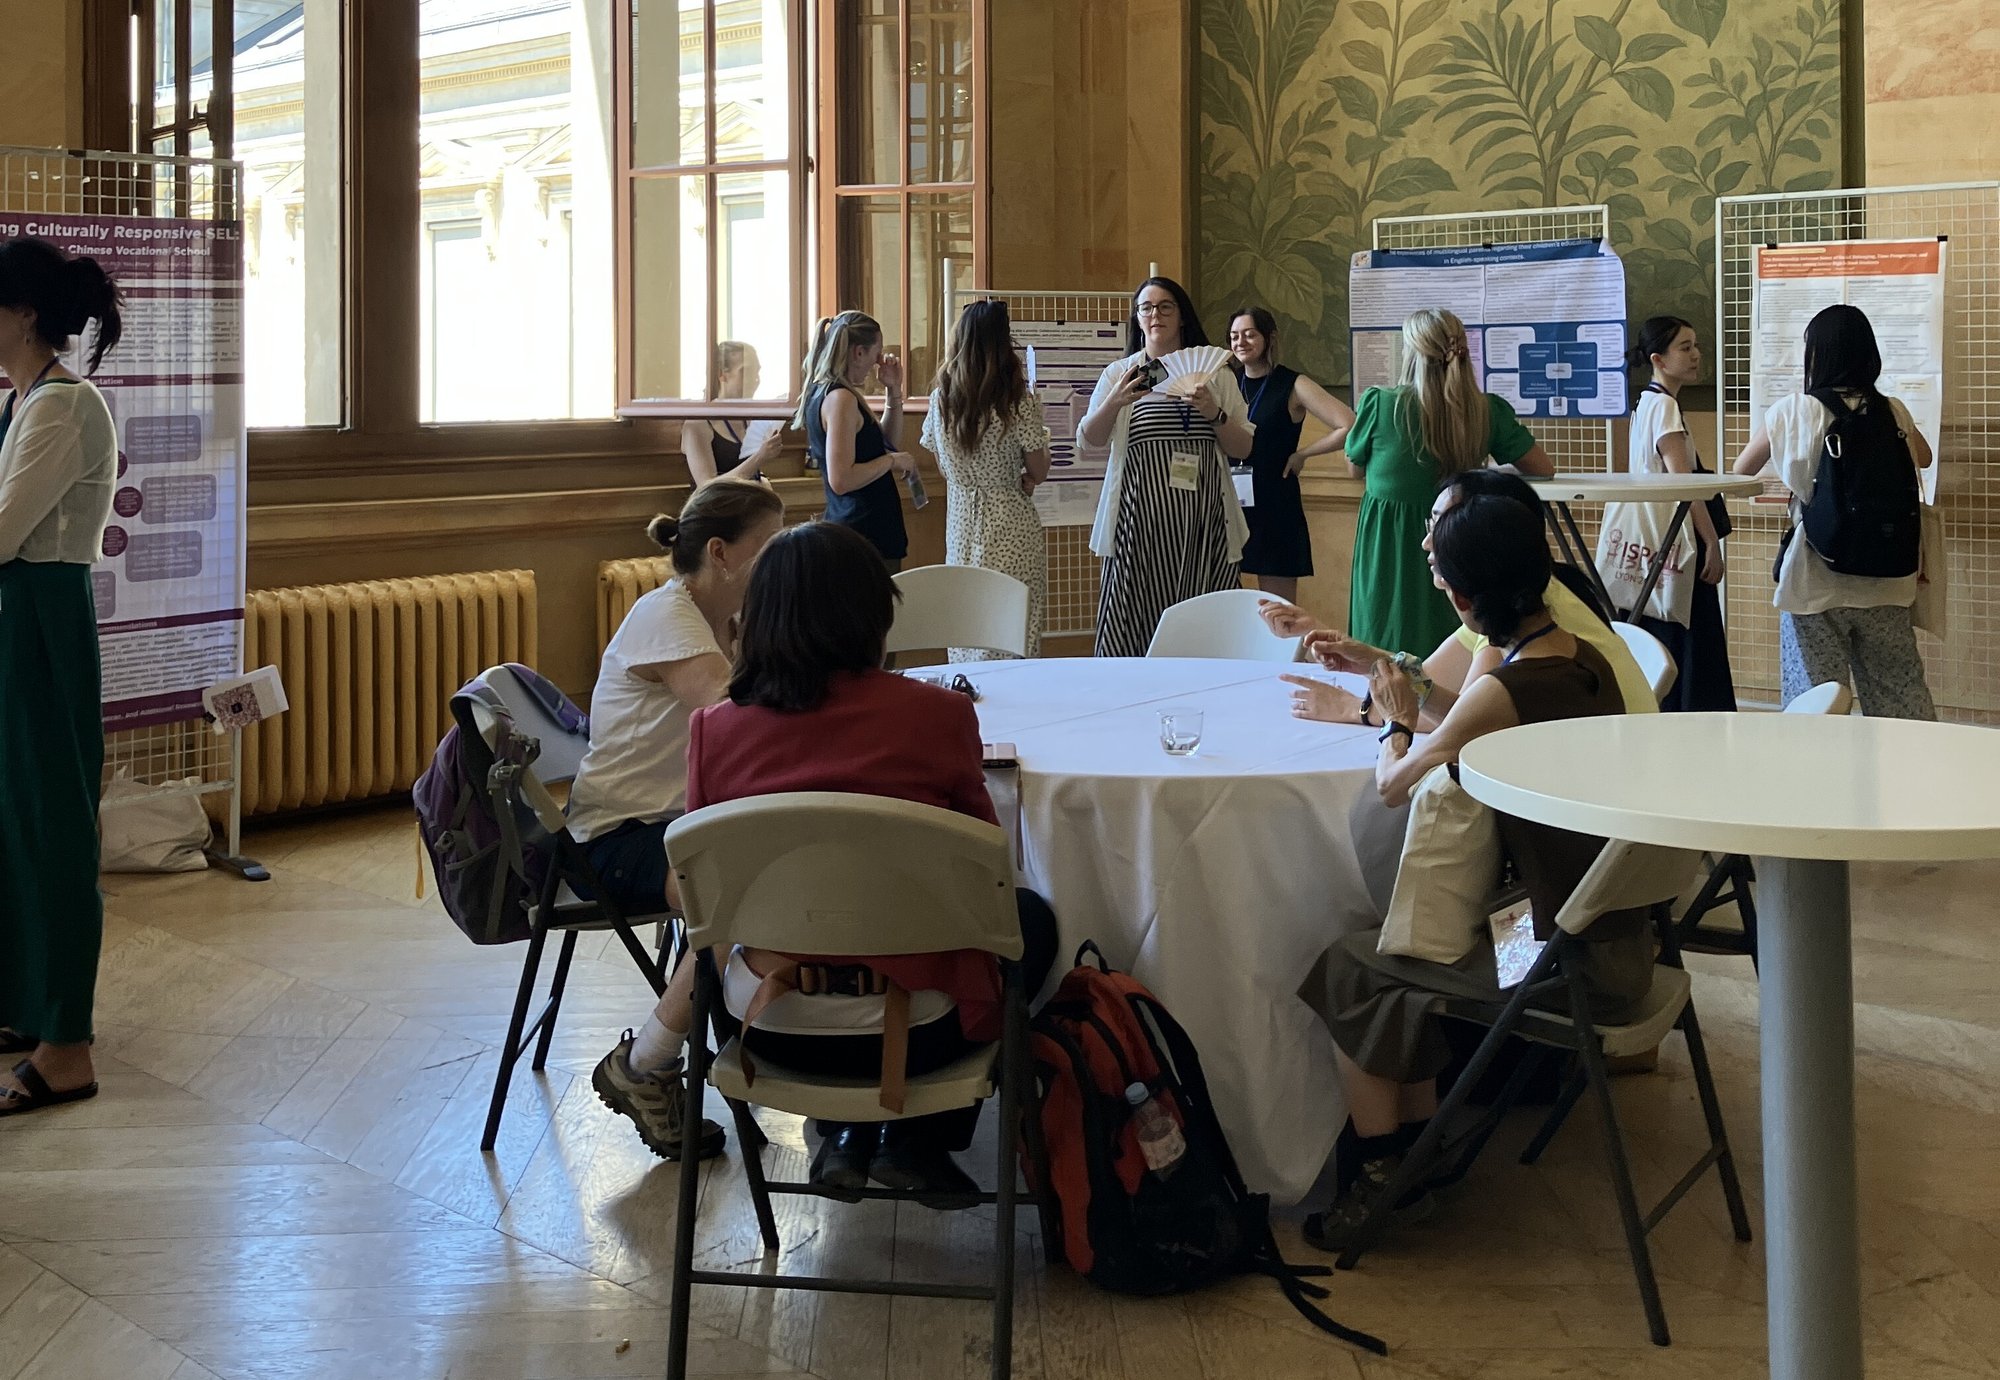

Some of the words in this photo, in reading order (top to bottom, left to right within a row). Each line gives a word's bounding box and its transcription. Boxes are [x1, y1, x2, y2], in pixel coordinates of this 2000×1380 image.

[25, 222, 109, 240] Culturally
[114, 225, 202, 241] Responsive
[205, 227, 240, 240] SEL:
[68, 244, 113, 255] Chinese
[174, 246, 211, 256] School
